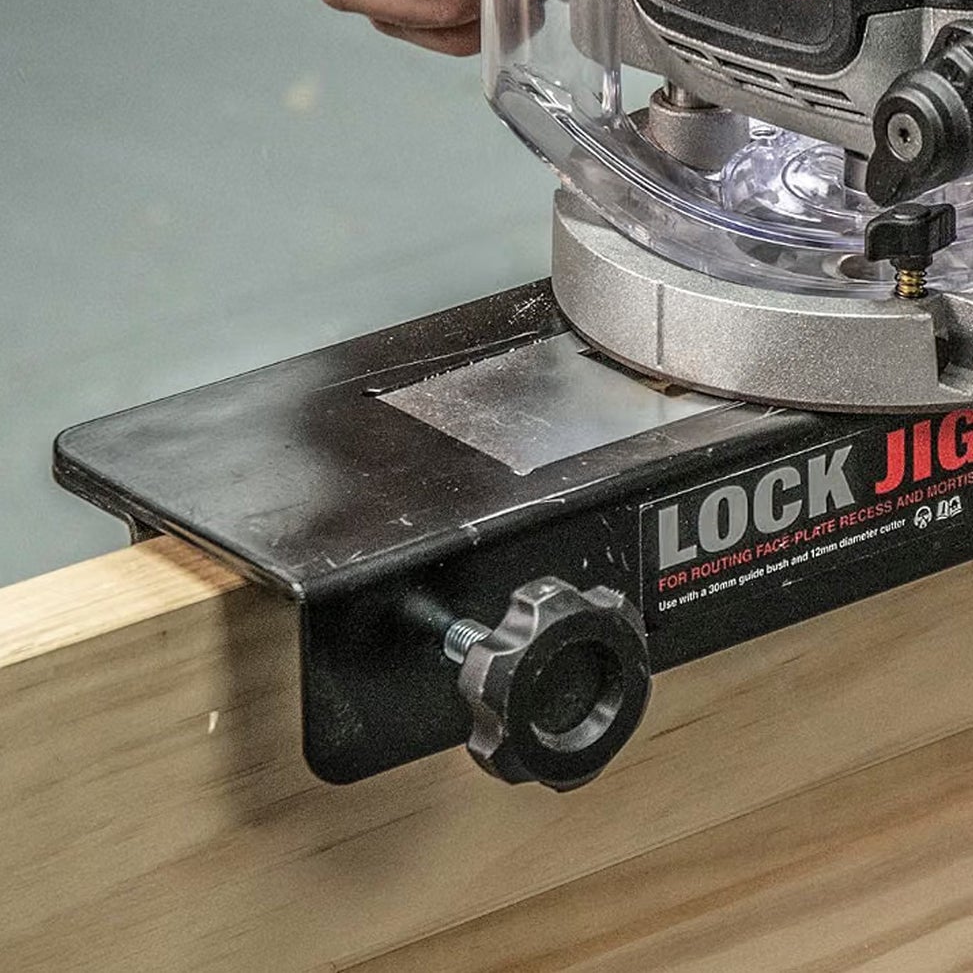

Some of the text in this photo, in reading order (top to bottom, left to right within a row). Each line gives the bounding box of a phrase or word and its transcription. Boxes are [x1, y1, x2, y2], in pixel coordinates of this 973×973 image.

[658, 445, 855, 570] LOCK
[658, 572, 687, 593] FOR
[691, 549, 753, 581] ROUTING
[756, 519, 836, 558] FACE-PLATE
[839, 500, 893, 528] RECESS
[896, 489, 924, 510] AND
[658, 518, 907, 612] Use with a 30mm guide bush and 12mm diameter cutter
